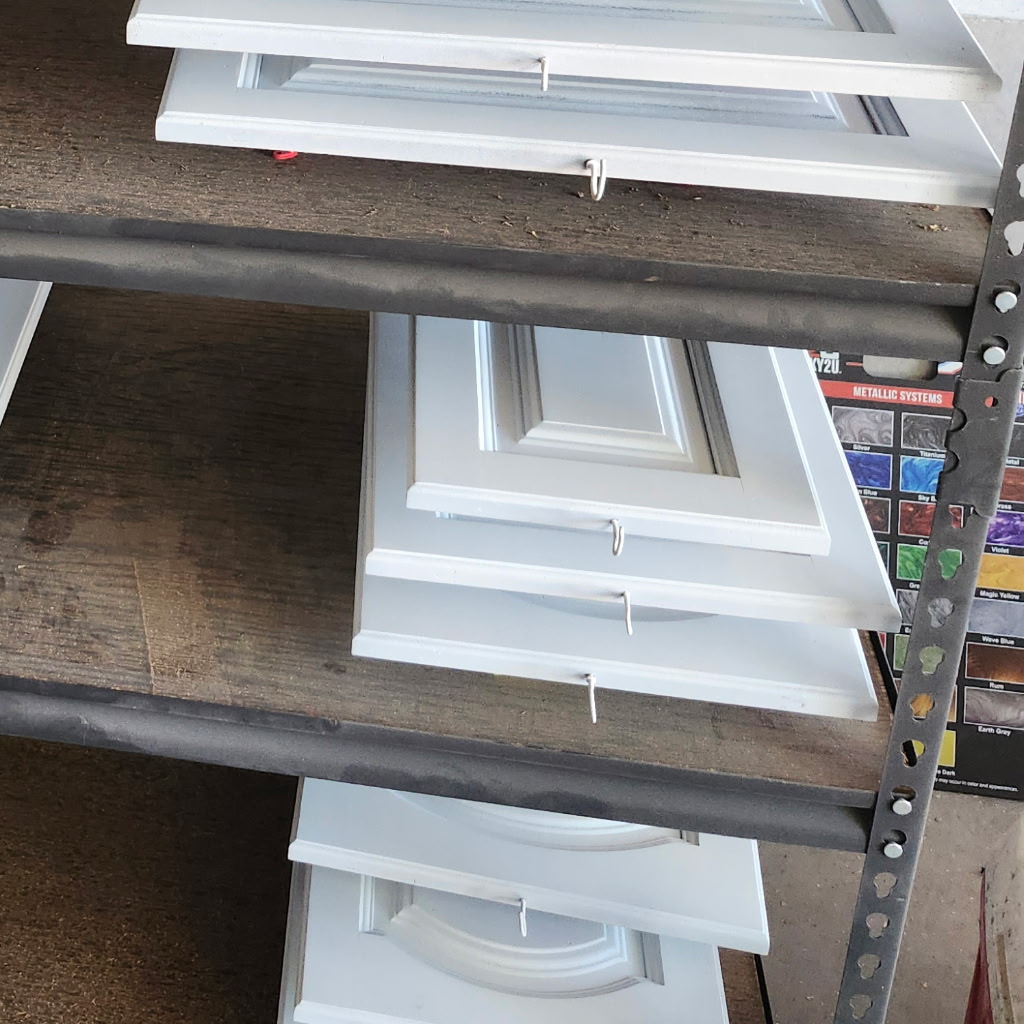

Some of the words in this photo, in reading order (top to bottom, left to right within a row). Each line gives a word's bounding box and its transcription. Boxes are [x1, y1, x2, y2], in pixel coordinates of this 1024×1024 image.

[853, 386, 897, 399] METALLIC
[900, 391, 942, 404] SYSTEMS
[920, 450, 946, 458] Titanium
[991, 546, 1009, 554] Violet
[980, 590, 998, 598] Magic
[1000, 591, 1020, 600] Yellow
[982, 635, 999, 643] Wave
[1000, 637, 1015, 645] Blue
[978, 726, 995, 734] Earth
